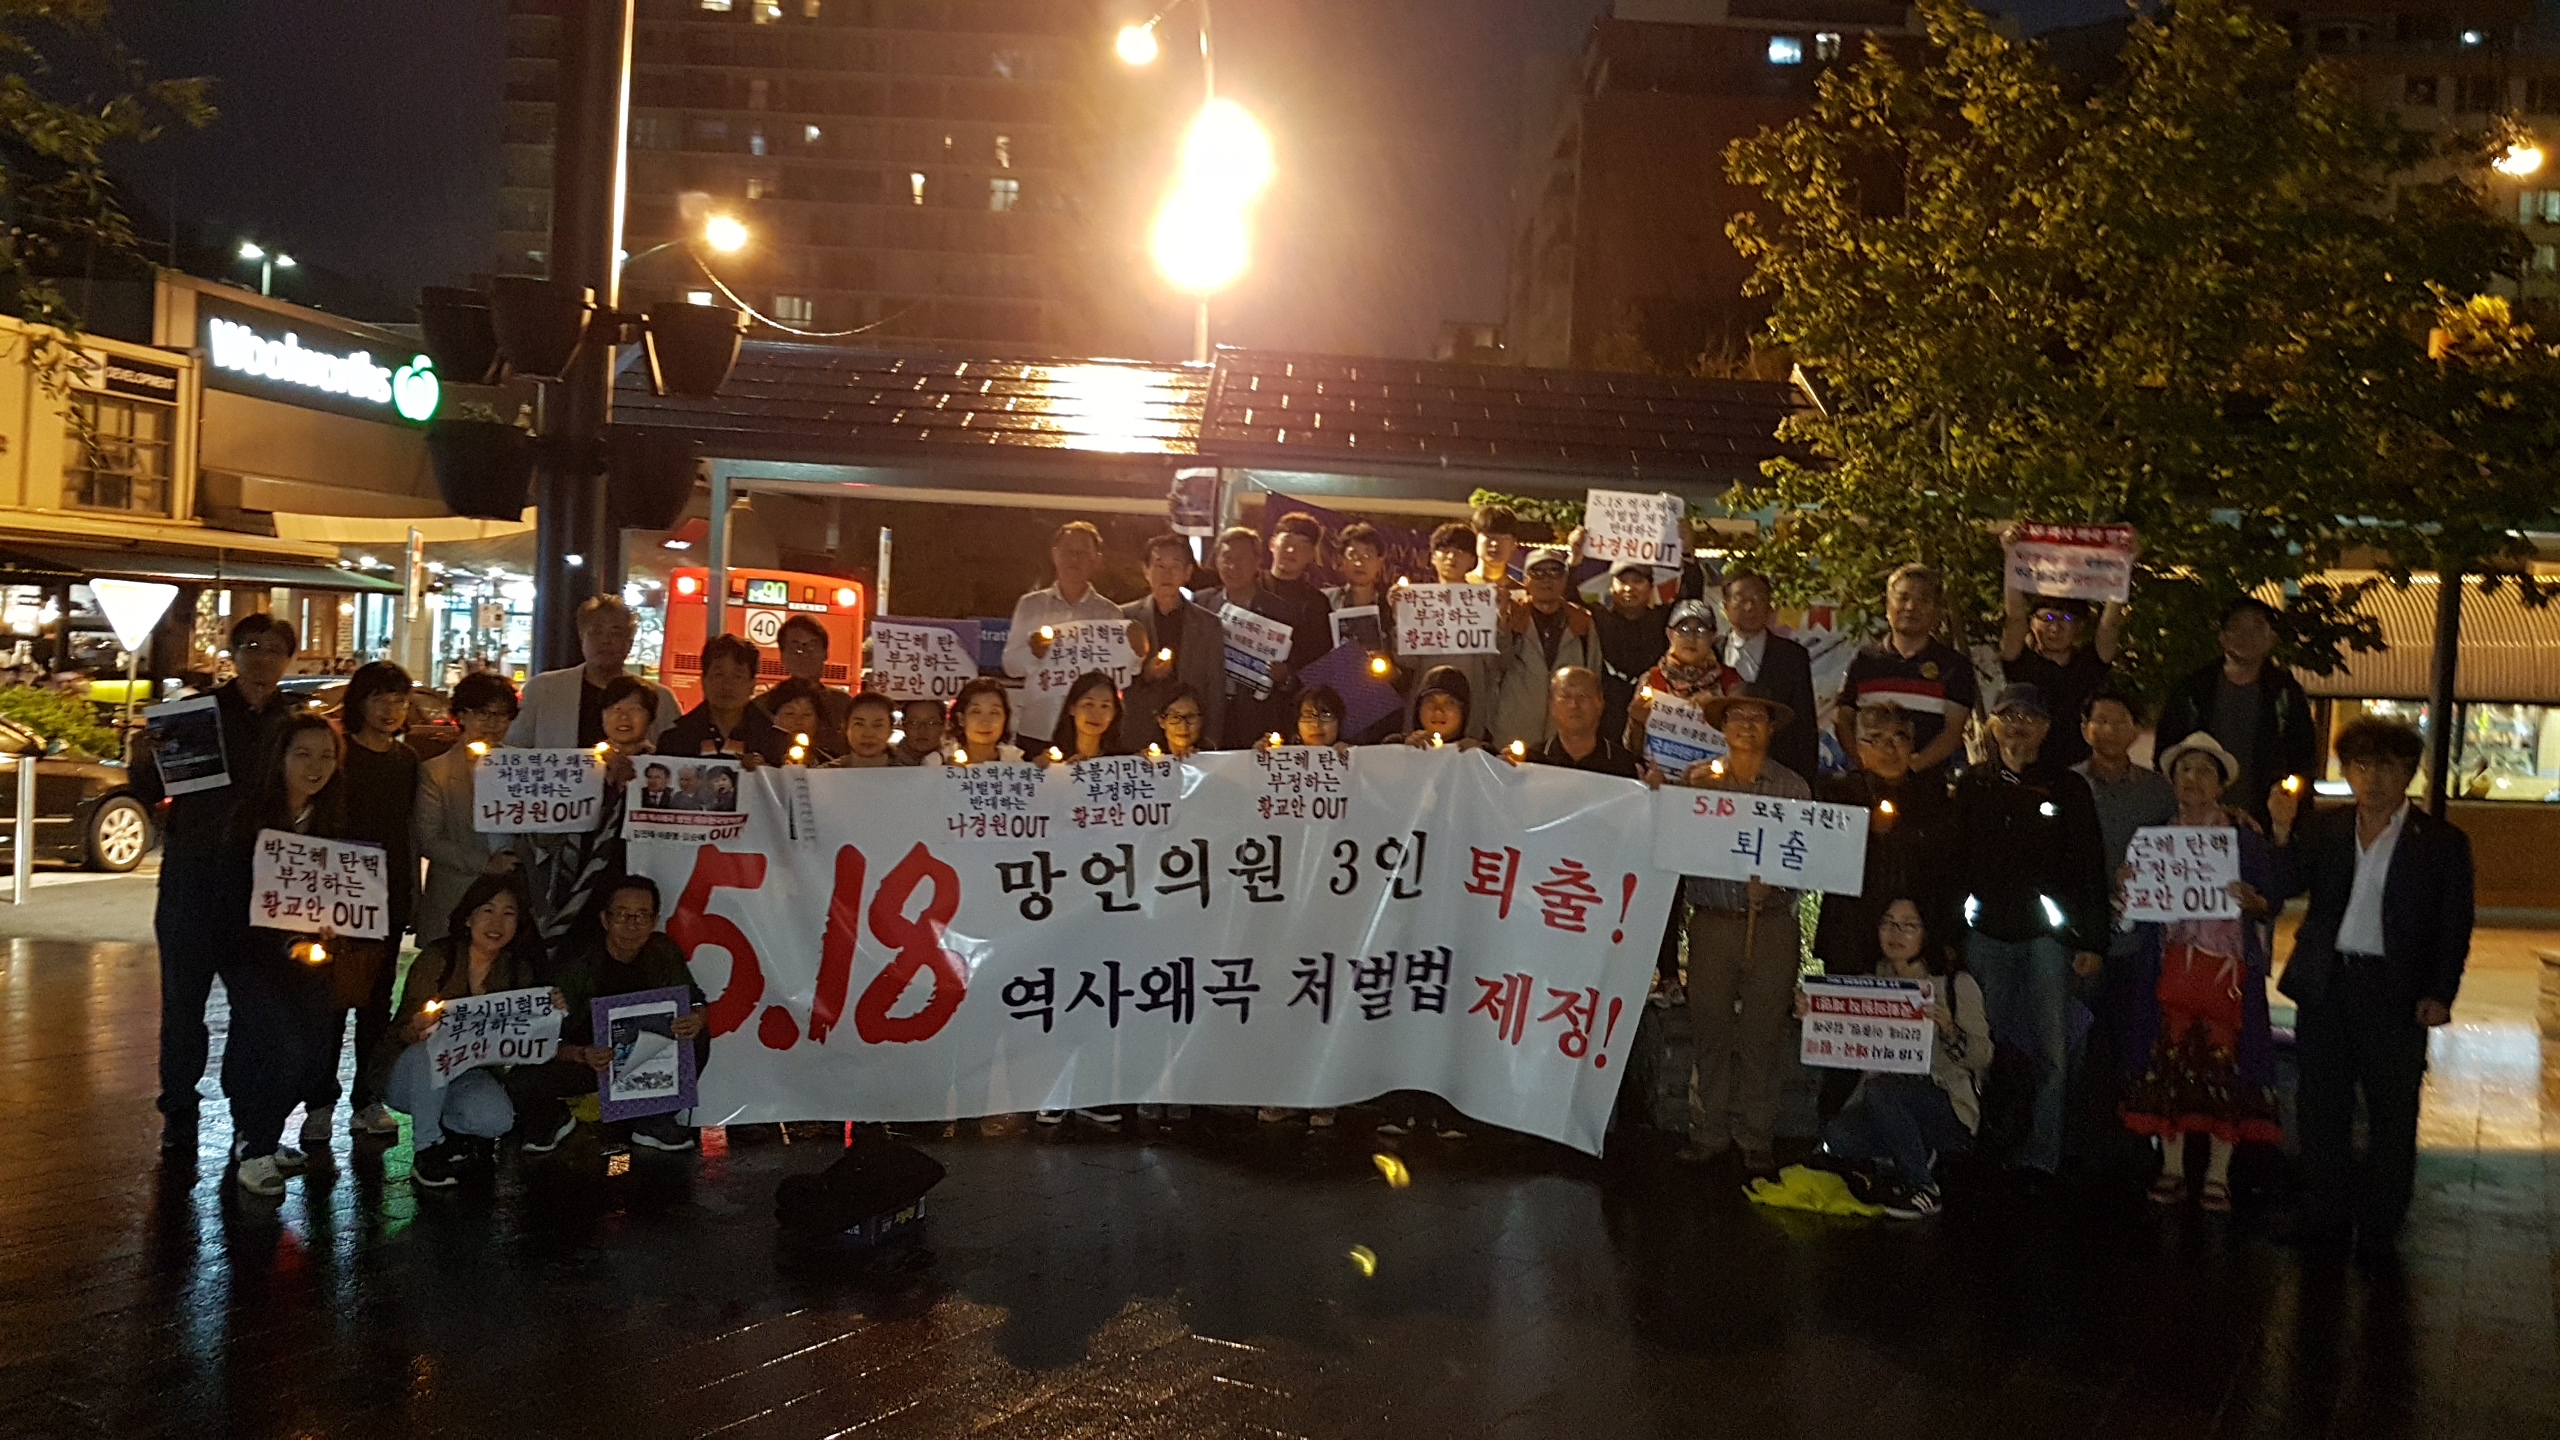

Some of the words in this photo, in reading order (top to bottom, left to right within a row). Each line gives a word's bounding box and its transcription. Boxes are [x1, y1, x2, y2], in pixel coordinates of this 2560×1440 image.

[210, 318, 391, 402] Woolworths
[1641, 542, 1676, 562] OUT
[1415, 607, 1480, 626] 부정하는
[753, 620, 775, 637] 40
[1406, 628, 1450, 649] 황교안
[1457, 629, 1491, 648] OUT
[877, 629, 929, 652] 박근혜
[937, 634, 954, 652] 탄
[886, 651, 959, 671] 부정하는
[1051, 645, 1110, 665] 부정하는
[874, 671, 925, 695] 황교안
[483, 754, 521, 766] 5.18
[527, 753, 559, 767] 역사
[1257, 750, 1309, 771] 박근혜
[498, 767, 545, 782] 처벌법
[554, 768, 584, 783] 제정
[946, 766, 981, 780] 5.18
[987, 767, 1014, 781] 역사
[1268, 772, 1340, 793] 부정하는
[507, 783, 572, 797] 반대하는
[961, 781, 1003, 796] 처벌법
[1009, 782, 1035, 797] 제정
[1087, 780, 1155, 802] 부정하는
[482, 800, 547, 825] 나경원
[553, 797, 596, 822] OUT
[970, 797, 1027, 811] 반대하는
[1258, 795, 1306, 819] 황교안
[1313, 797, 1348, 819] OUT
[1693, 796, 1735, 817] 5.18
[947, 812, 1008, 838] 나경원
[1011, 816, 1049, 838] OUT
[1071, 803, 1126, 828] 황교안
[1132, 803, 1171, 826] OUT
[709, 827, 741, 840] OUT
[2131, 834, 2175, 858] 근혜
[265, 839, 327, 870] 박근혜
[339, 851, 378, 877] 탄핵
[276, 866, 365, 898] 부정하는
[262, 890, 325, 922] 황교안
[333, 902, 379, 929] OUT
[2183, 886, 2228, 913] OUT
[665, 841, 968, 1050] 5.18
[994, 833, 1286, 921] 망언의원
[1464, 845, 1638, 944] 퇴출!
[1002, 956, 1261, 1033] 역사왜곡
[1288, 946, 1453, 1024] 처벌법
[1468, 972, 1622, 1069] 제정!
[450, 1017, 530, 1042] 부정하는
[500, 1038, 548, 1058] OUT
